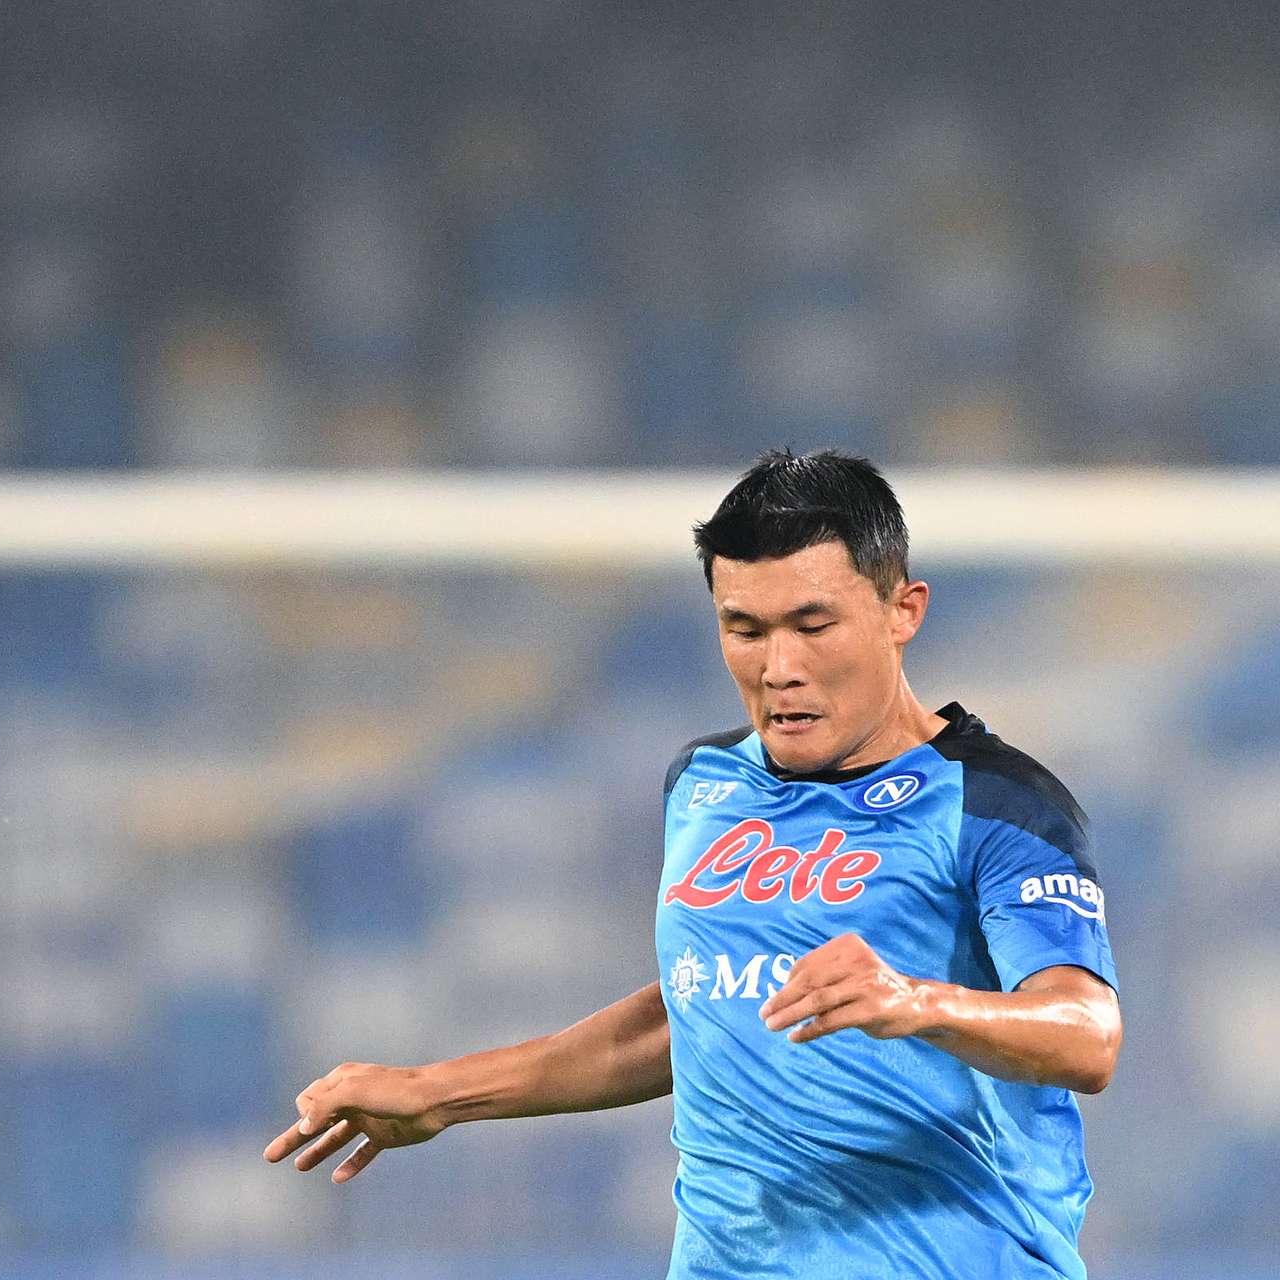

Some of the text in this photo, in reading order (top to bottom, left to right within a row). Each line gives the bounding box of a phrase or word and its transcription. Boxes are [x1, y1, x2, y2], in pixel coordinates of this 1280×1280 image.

[665, 818, 881, 909] Lete
[1020, 873, 1104, 906] ama
[708, 953, 796, 1000] MS
